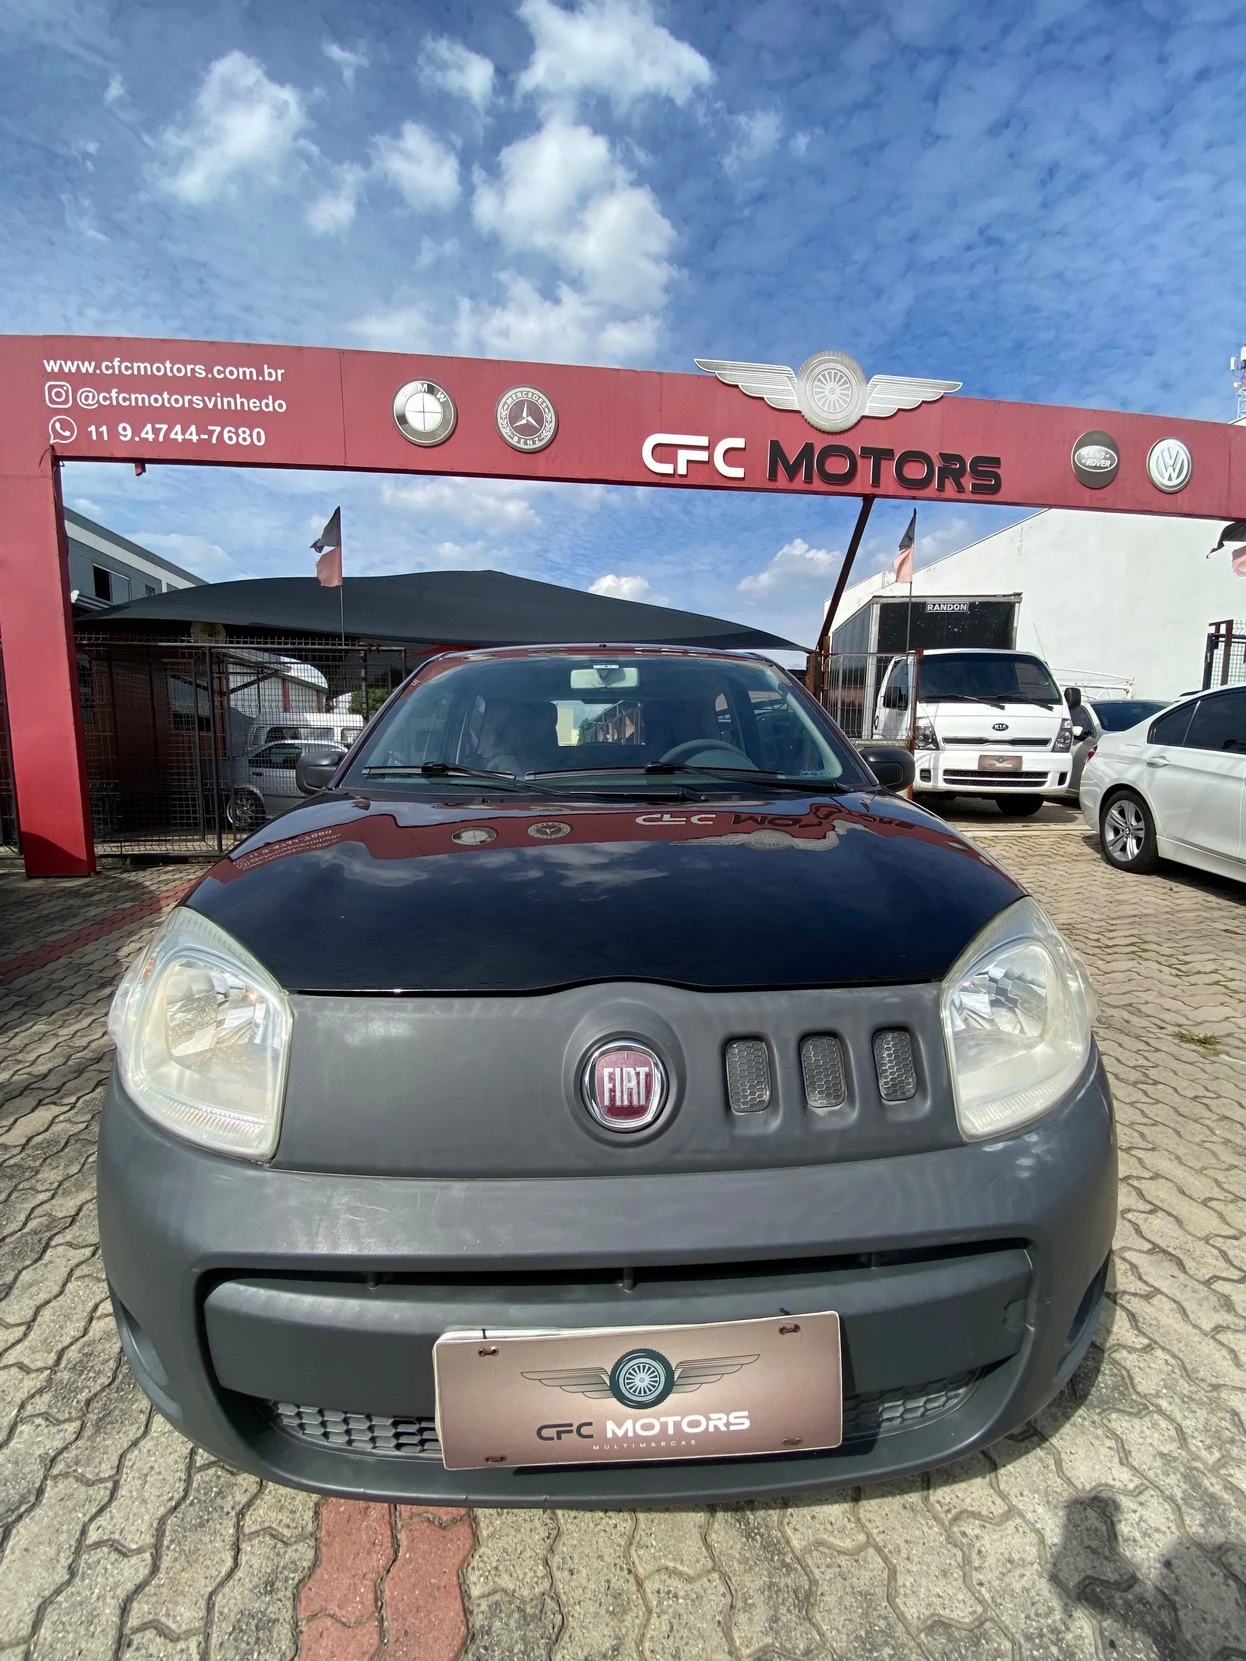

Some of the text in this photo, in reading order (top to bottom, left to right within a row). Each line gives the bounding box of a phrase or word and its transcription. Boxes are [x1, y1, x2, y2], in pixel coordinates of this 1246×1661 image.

[43, 358, 285, 382] www.cfcmotors.com.br
[77, 388, 287, 413] @cfcmotorsvinhedo
[506, 391, 547, 408] MERCEDES
[87, 423, 266, 447] 11 9.4744-7680
[513, 436, 541, 446] BENZ
[642, 433, 1002, 494] CFC MOTORS
[1086, 459, 1111, 468] ROVER
[927, 603, 967, 611] RANDON
[603, 1067, 648, 1106] FIAT
[536, 1410, 751, 1442] CFC MOTORS
[592, 1439, 697, 1450] MULTIMARCAS
